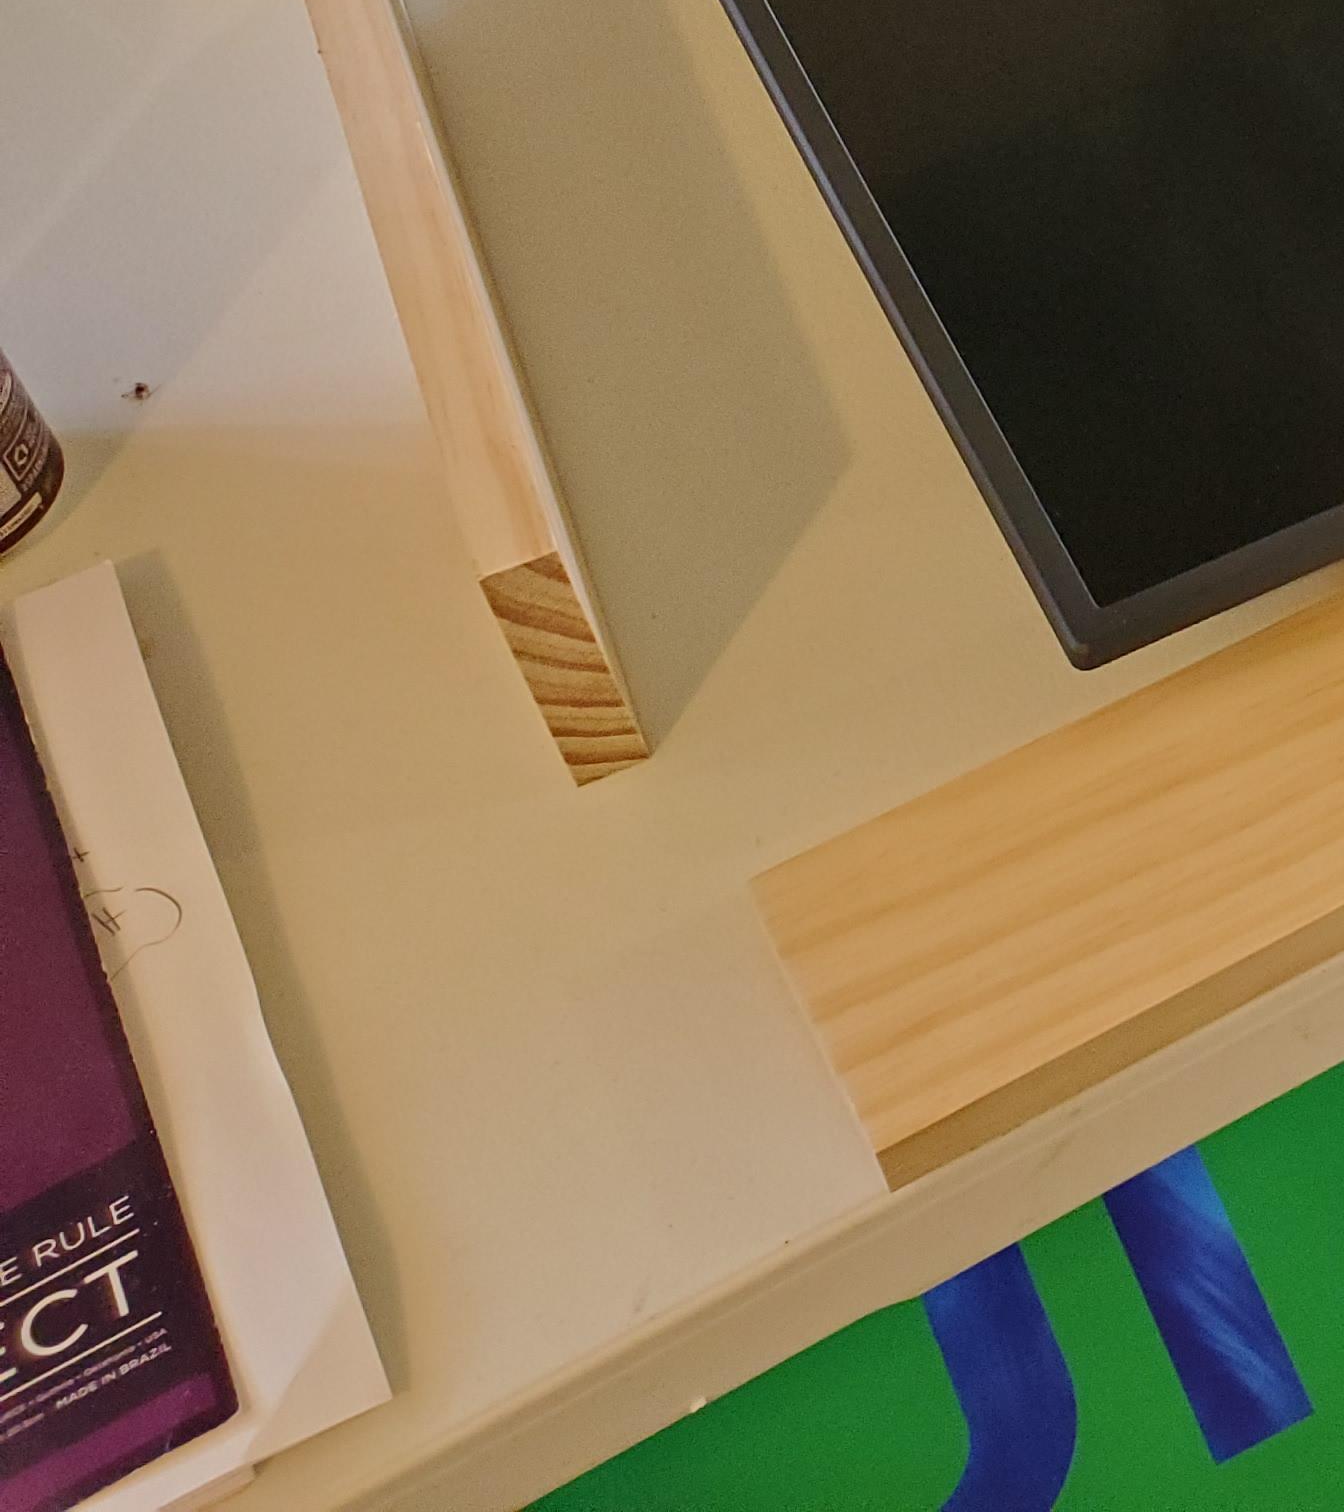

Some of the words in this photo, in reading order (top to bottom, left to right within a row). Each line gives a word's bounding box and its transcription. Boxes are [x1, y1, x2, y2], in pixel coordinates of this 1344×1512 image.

[32, 1195, 135, 1267] RULE
[55, 1380, 98, 1409] MADE
[101, 1370, 118, 1386] IN
[118, 1342, 172, 1376] BRAZIL
